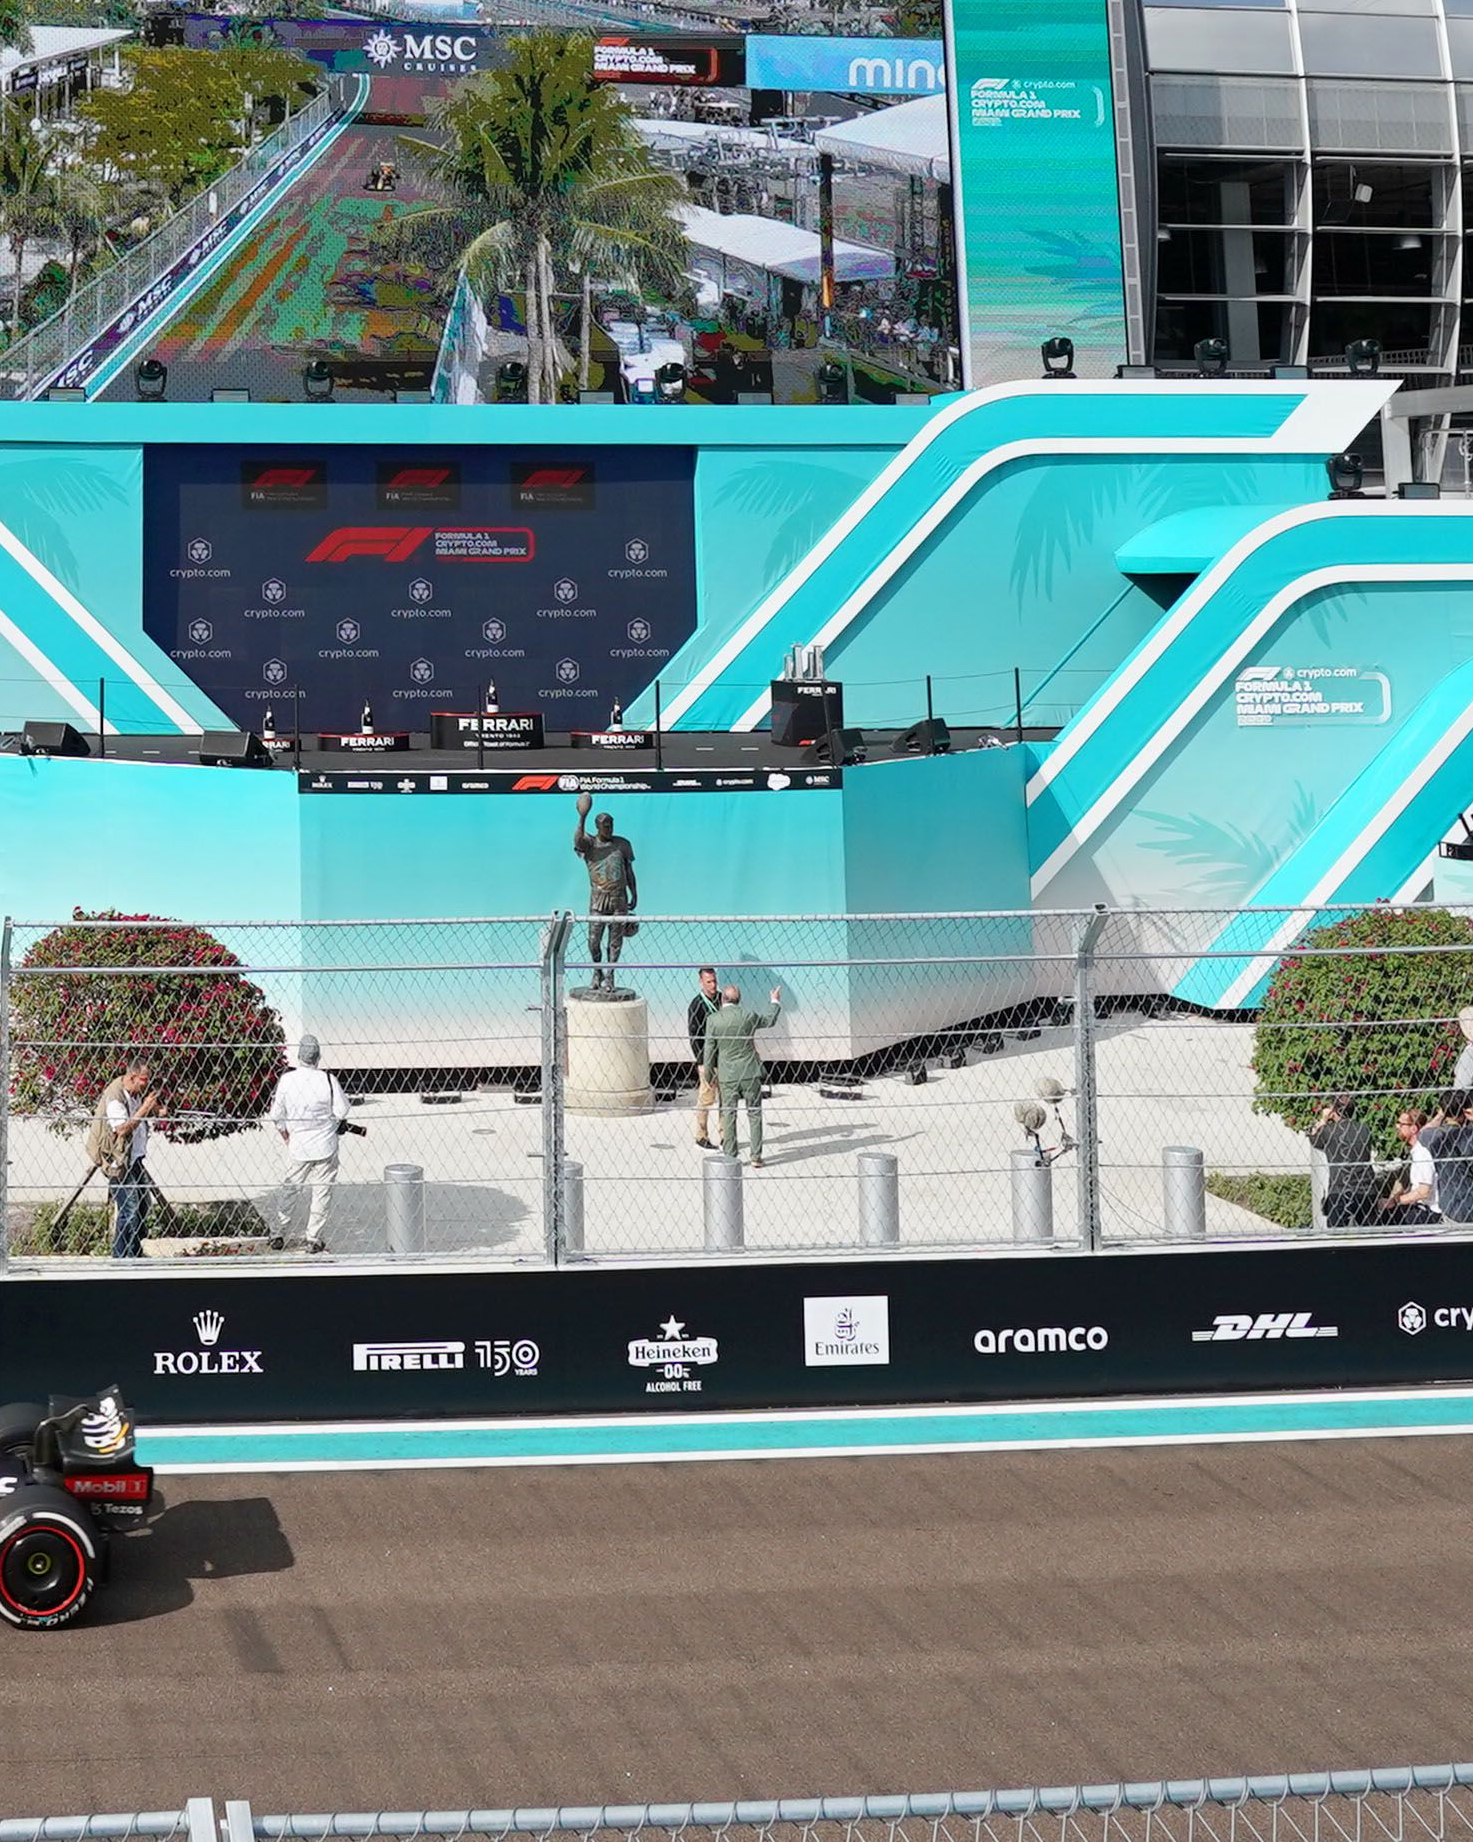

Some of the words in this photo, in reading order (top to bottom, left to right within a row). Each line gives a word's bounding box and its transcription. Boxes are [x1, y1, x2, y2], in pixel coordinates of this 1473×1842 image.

[404, 35, 477, 61] MSC
[170, 568, 231, 578] crypto.com
[608, 568, 667, 578] crypto.com
[244, 608, 305, 619] crypto.com
[391, 608, 451, 619] crypto.com
[536, 608, 597, 618] crypto.com
[170, 648, 231, 659] crypto.com
[318, 648, 379, 659] crypto.com
[465, 648, 525, 658] crypto.com
[610, 647, 669, 657] crypto.com
[1297, 668, 1357, 678] crypto.com
[1235, 681, 1302, 691] FORMULA
[392, 688, 453, 699] crypto.com
[538, 688, 598, 698] crypto.com
[1236, 693, 1322, 702] CRYPTO.COM
[1282, 704, 1330, 713] GRAND
[1331, 703, 1363, 713] PRIX
[458, 718, 534, 731] FERRARI
[341, 736, 395, 747] FERRARI
[591, 735, 645, 747] FERRARI
[1210, 1312, 1317, 1341] DHL
[973, 1326, 1109, 1354] aramco
[635, 1344, 712, 1360] Heineken
[814, 1339, 880, 1357] Emirates
[353, 1341, 465, 1371] PIRELLI
[154, 1350, 264, 1374] ROLEX
[514, 1367, 538, 1376] YEARS
[645, 1382, 681, 1393] ALCOHOL
[683, 1380, 702, 1391] FREE
[74, 1480, 126, 1493] Mobil
[104, 1502, 143, 1515] Tezos
